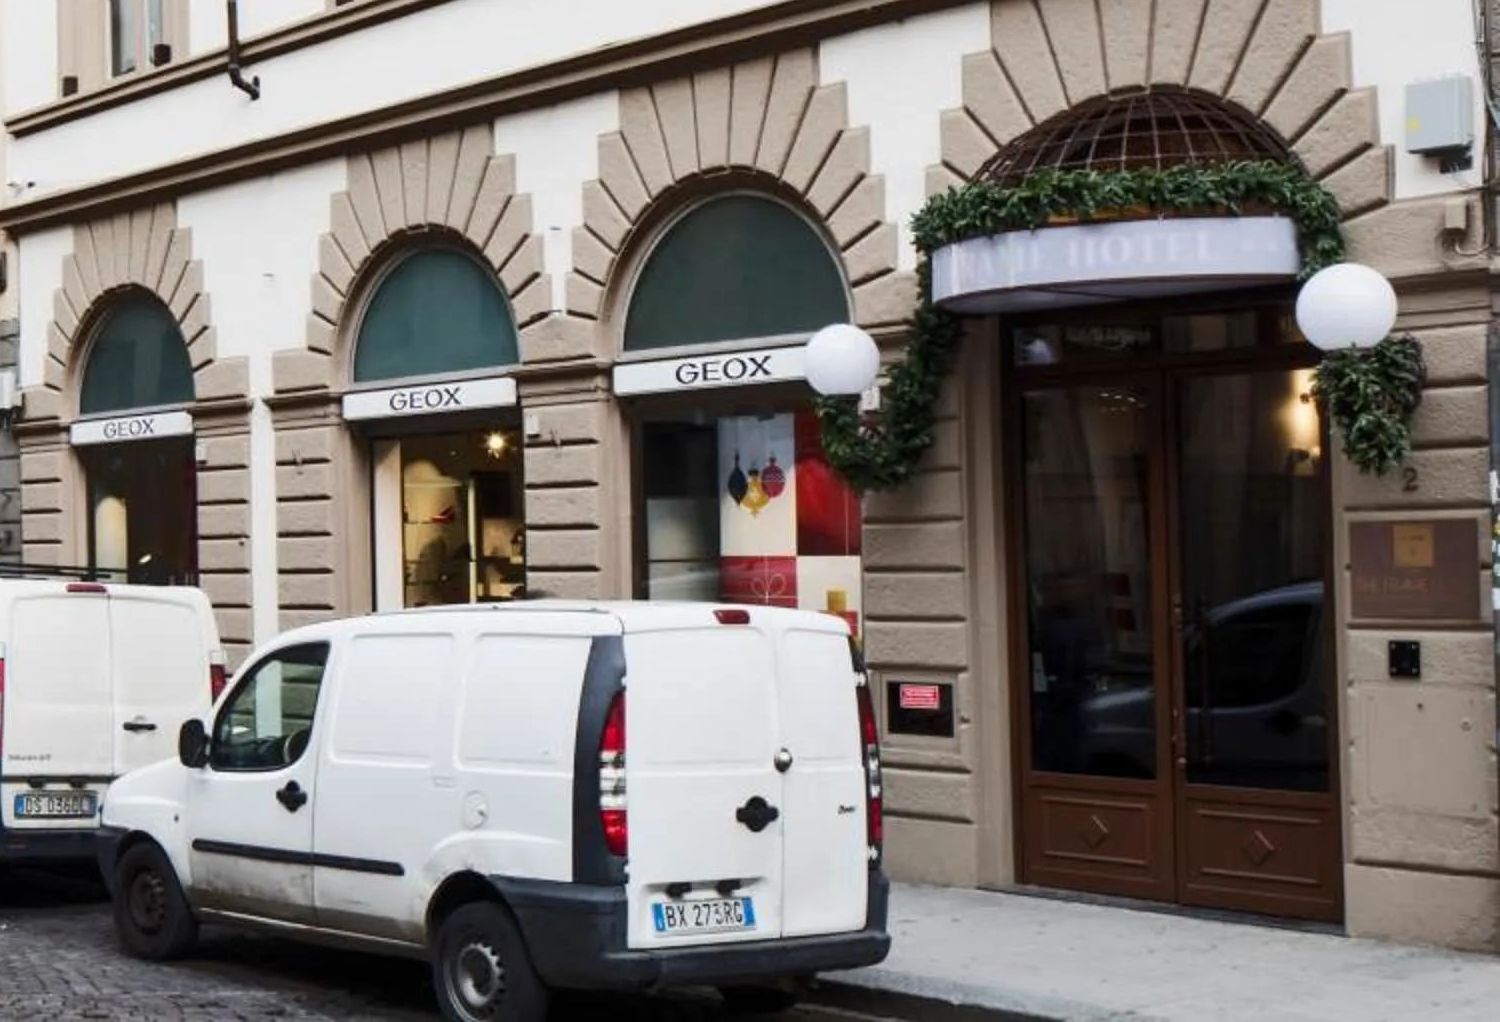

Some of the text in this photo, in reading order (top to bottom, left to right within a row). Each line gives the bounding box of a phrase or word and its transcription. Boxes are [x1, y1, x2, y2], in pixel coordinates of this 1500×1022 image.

[675, 355, 772, 386] GEOX
[389, 386, 462, 412] GEOX
[102, 418, 155, 440] GEOX
[1402, 467, 1419, 492] 2
[664, 902, 688, 928] BX
